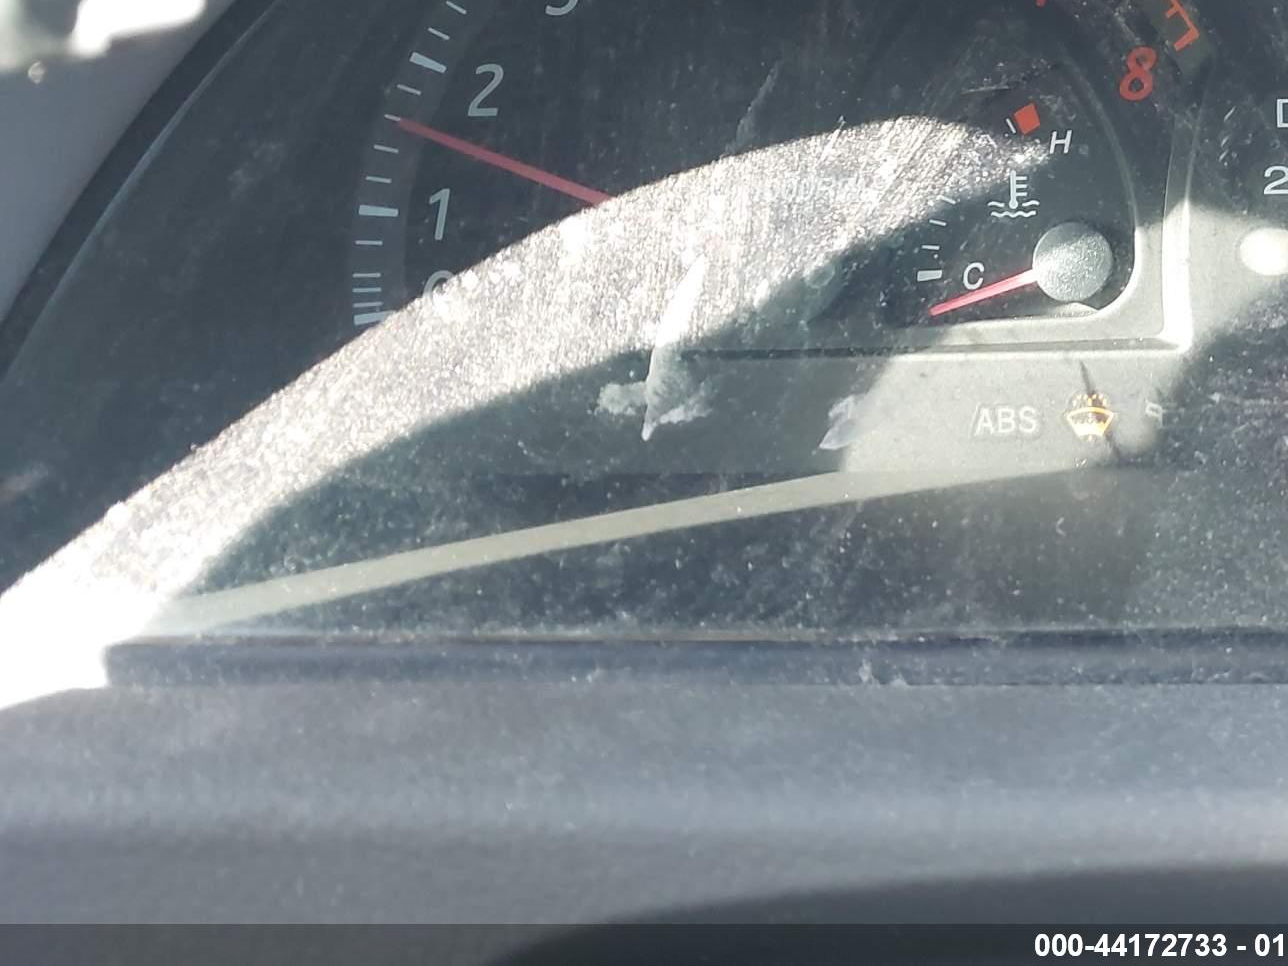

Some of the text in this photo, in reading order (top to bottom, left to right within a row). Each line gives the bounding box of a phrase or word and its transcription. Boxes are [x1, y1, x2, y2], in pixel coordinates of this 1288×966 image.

[467, 64, 504, 117] 2
[1119, 46, 1157, 101] 8
[1048, 131, 1072, 155] H
[428, 188, 451, 241] 1
[963, 262, 985, 291] C
[975, 406, 1038, 434] ABS
